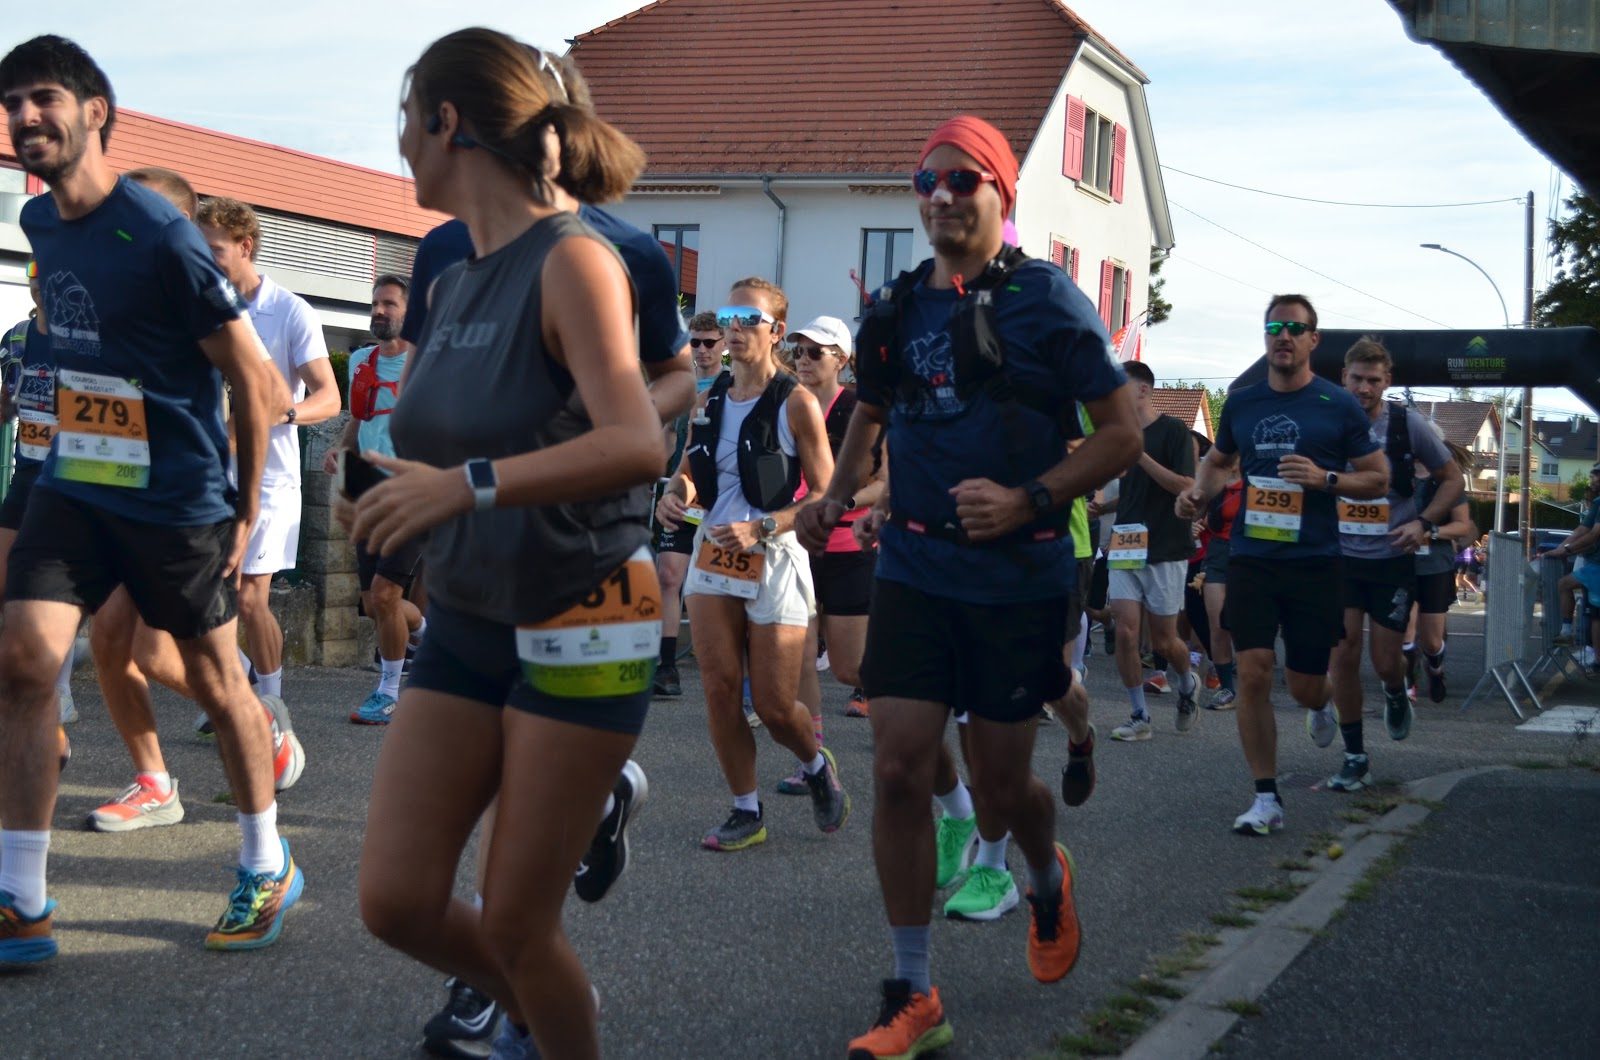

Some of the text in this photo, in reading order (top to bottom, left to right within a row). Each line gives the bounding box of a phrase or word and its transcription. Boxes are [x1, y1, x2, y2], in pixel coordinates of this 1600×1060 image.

[1447, 358, 1506, 368] RUNAVENTURE
[74, 395, 130, 427] 279
[20, 422, 51, 441] 234
[1256, 489, 1291, 508] 259
[1346, 504, 1380, 519] 299
[1117, 533, 1142, 546] 344
[710, 548, 750, 572] 235
